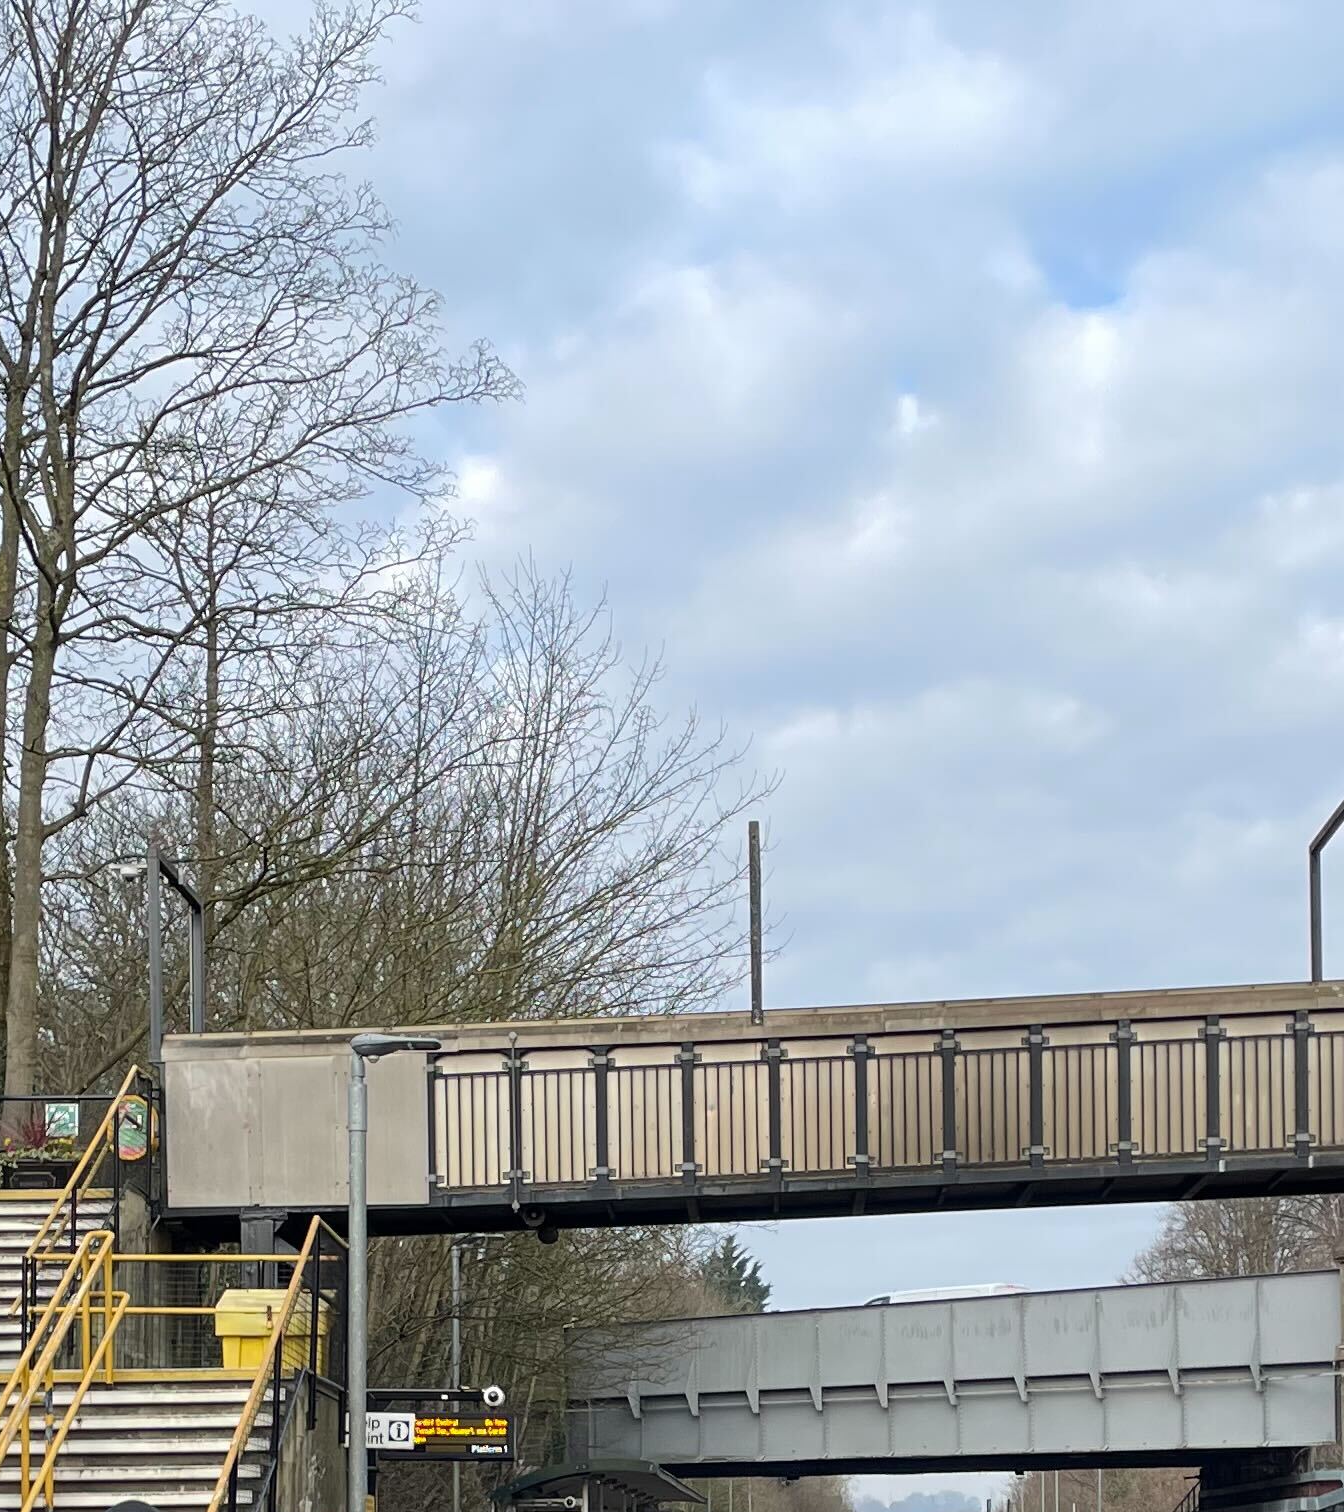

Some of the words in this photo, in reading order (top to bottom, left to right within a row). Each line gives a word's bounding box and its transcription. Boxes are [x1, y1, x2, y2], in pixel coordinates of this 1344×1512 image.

[366, 1416, 380, 1431] lp
[367, 1432, 384, 1445] int
[471, 1445, 503, 1454] Platform
